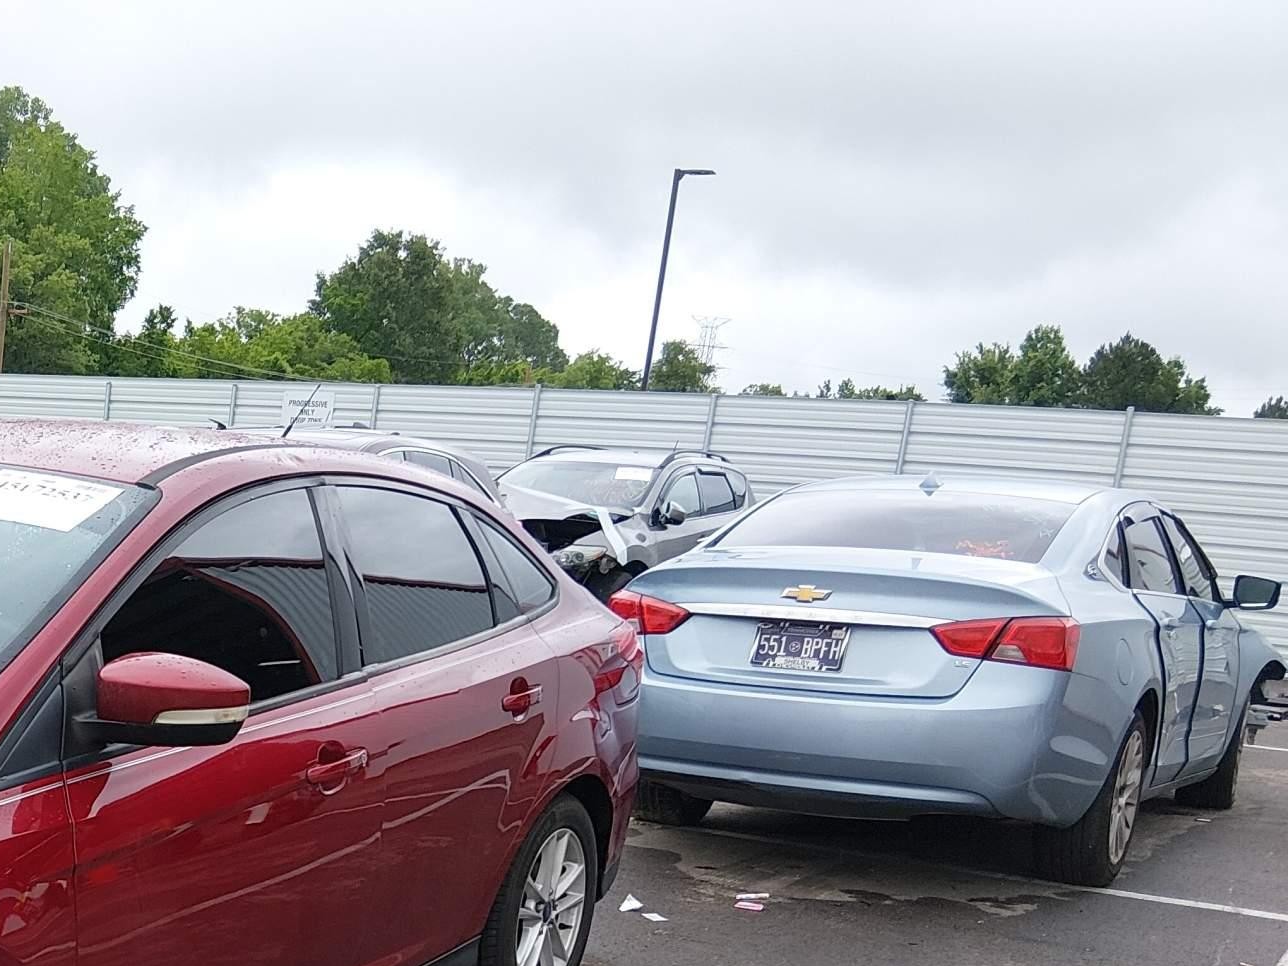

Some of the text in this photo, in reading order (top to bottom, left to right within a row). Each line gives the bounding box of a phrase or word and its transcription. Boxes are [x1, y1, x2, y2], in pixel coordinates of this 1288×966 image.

[300, 408, 315, 417] NLY
[758, 634, 842, 660] 551 BPFH
